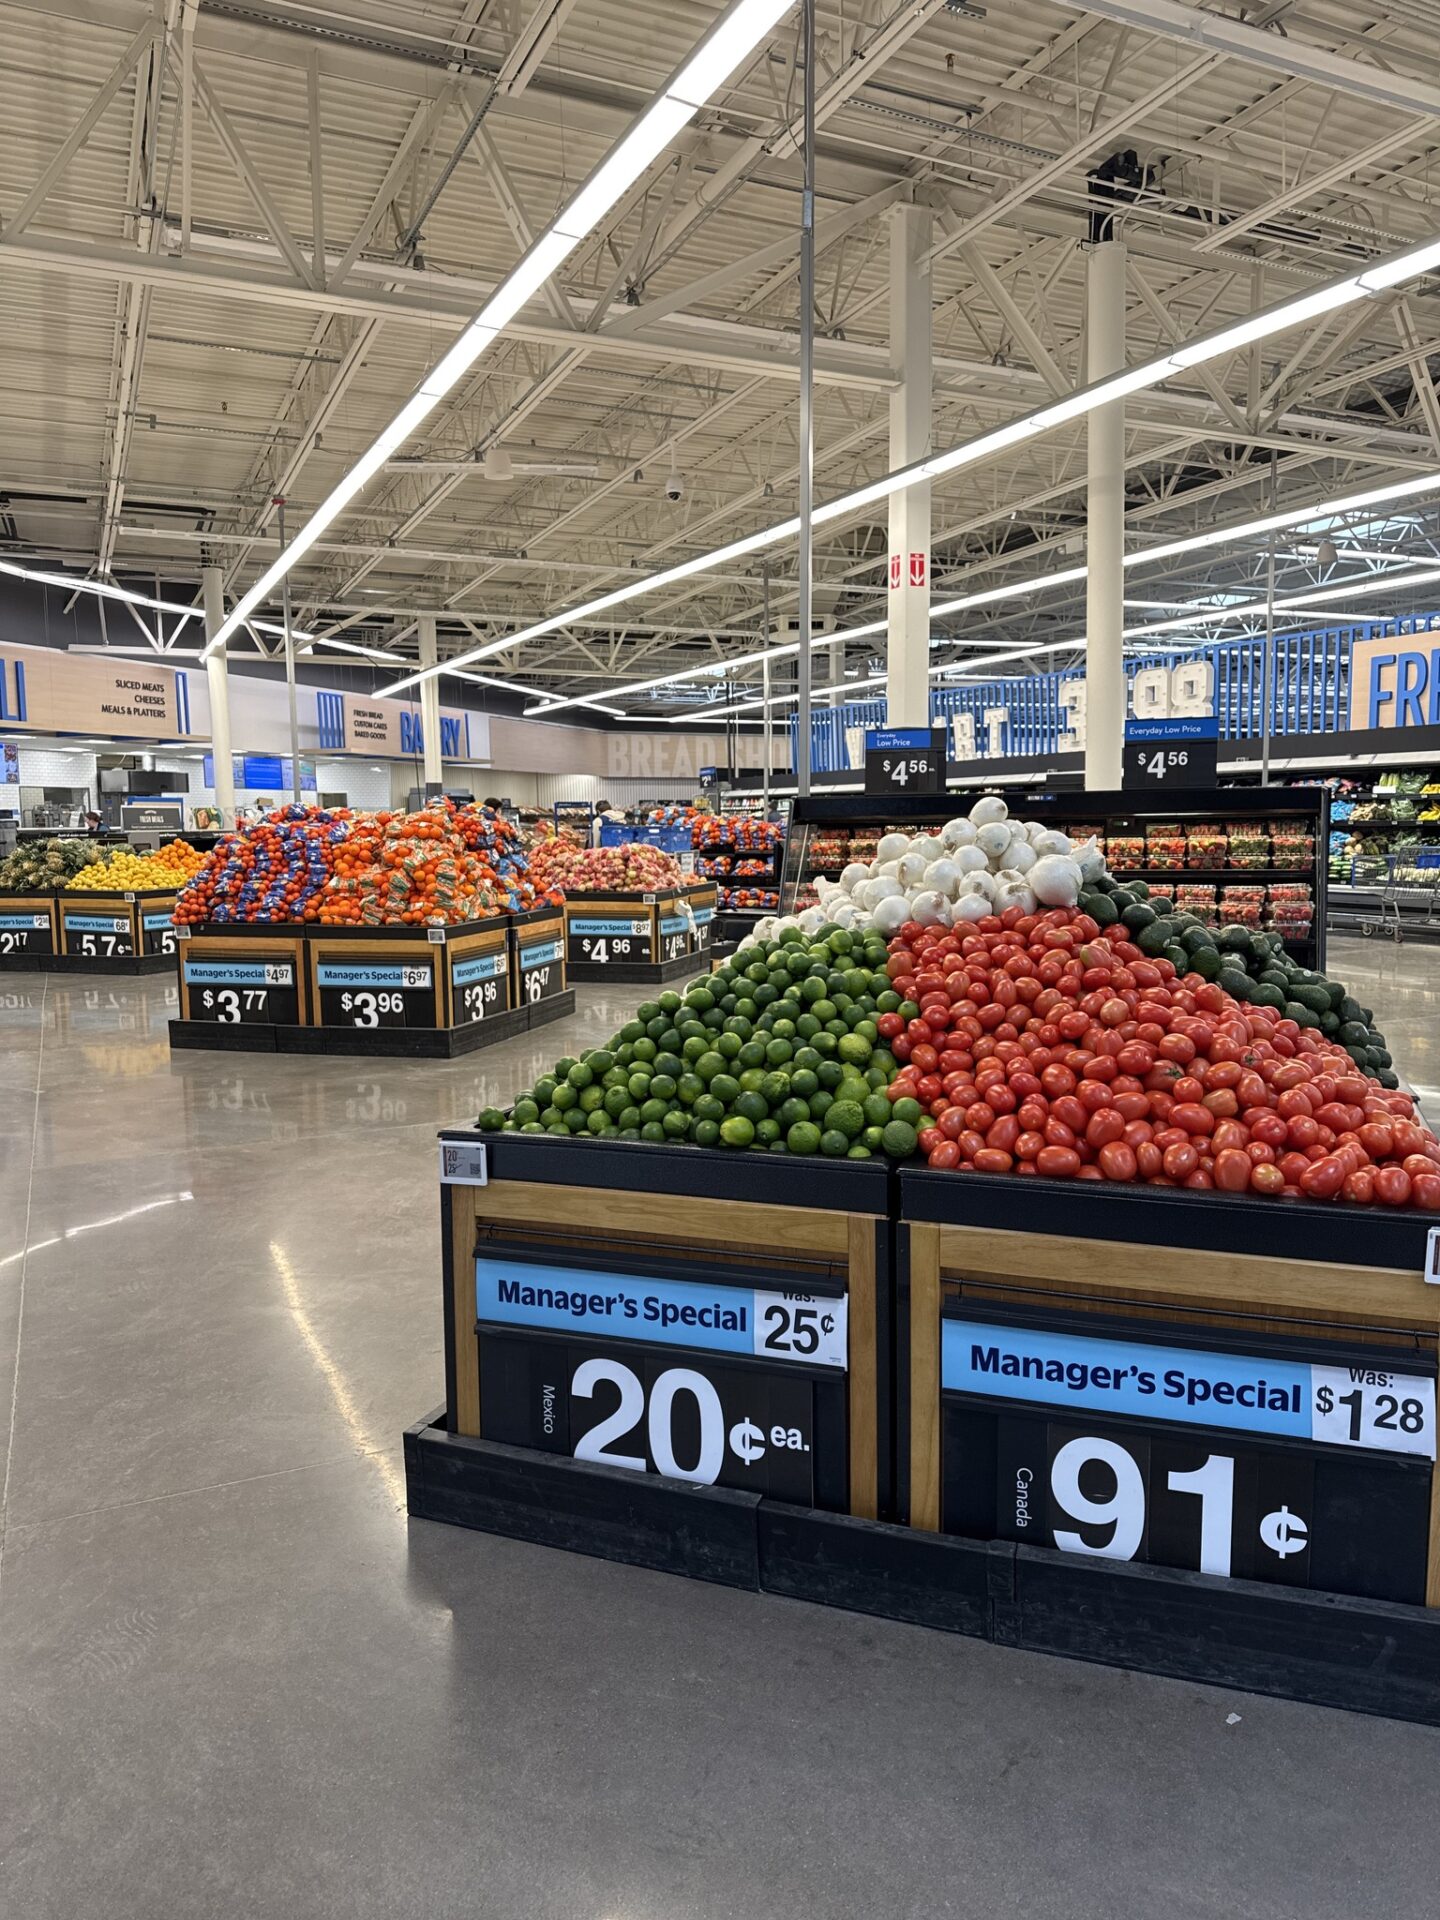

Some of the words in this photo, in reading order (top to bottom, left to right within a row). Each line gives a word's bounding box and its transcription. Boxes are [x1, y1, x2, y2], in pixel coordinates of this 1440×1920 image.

[115, 679, 141, 690] SLICED
[142, 682, 165, 692] MEATS
[134, 694, 165, 705] CHEESES
[101, 704, 126, 714] MEALS
[127, 707, 132, 715] &
[133, 707, 166, 718] PLATTERS
[400, 711, 460, 757] BARY
[1129, 726, 1163, 736] Everyday
[1164, 725, 1181, 734] Low
[1182, 725, 1202, 733] Price
[876, 739, 891, 747] Low
[893, 738, 911, 747] Price
[607, 734, 716, 778] BREAD
[68, 919, 95, 928] Manager's
[95, 920, 114, 929] Special
[575, 923, 608, 932] Manager's
[608, 924, 632, 932] Special
[190, 968, 233, 980] Manager's
[234, 968, 265, 981] Special
[324, 970, 370, 982] Manager's
[371, 971, 403, 983] Special
[498, 1279, 638, 1318] Manager's
[643, 1295, 747, 1332] Special
[764, 1305, 835, 1355] 25¢
[970, 1344, 1156, 1395] Manager's
[1163, 1370, 1302, 1414] Special
[1348, 1367, 1395, 1389] Was:
[542, 1383, 556, 1434] Mexico
[770, 1424, 811, 1452] ea.
[1015, 1466, 1034, 1528] Canada
